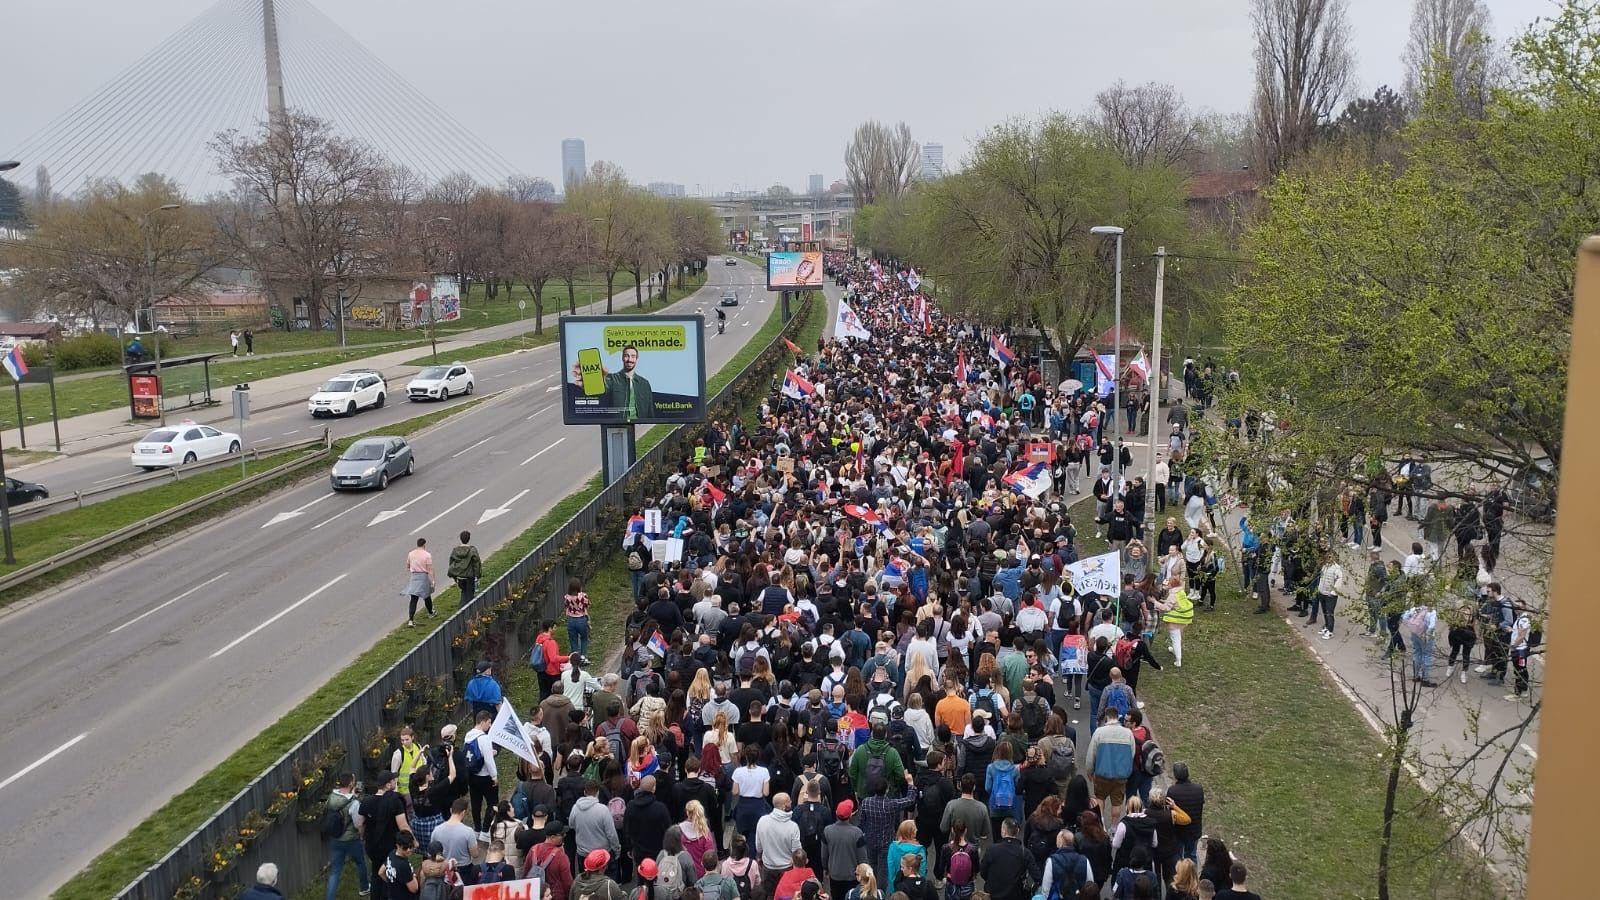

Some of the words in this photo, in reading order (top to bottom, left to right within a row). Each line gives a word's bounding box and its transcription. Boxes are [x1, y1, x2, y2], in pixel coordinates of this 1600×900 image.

[607, 338, 627, 348] bez
[631, 337, 683, 348] naknade.
[582, 363, 600, 372] MAX
